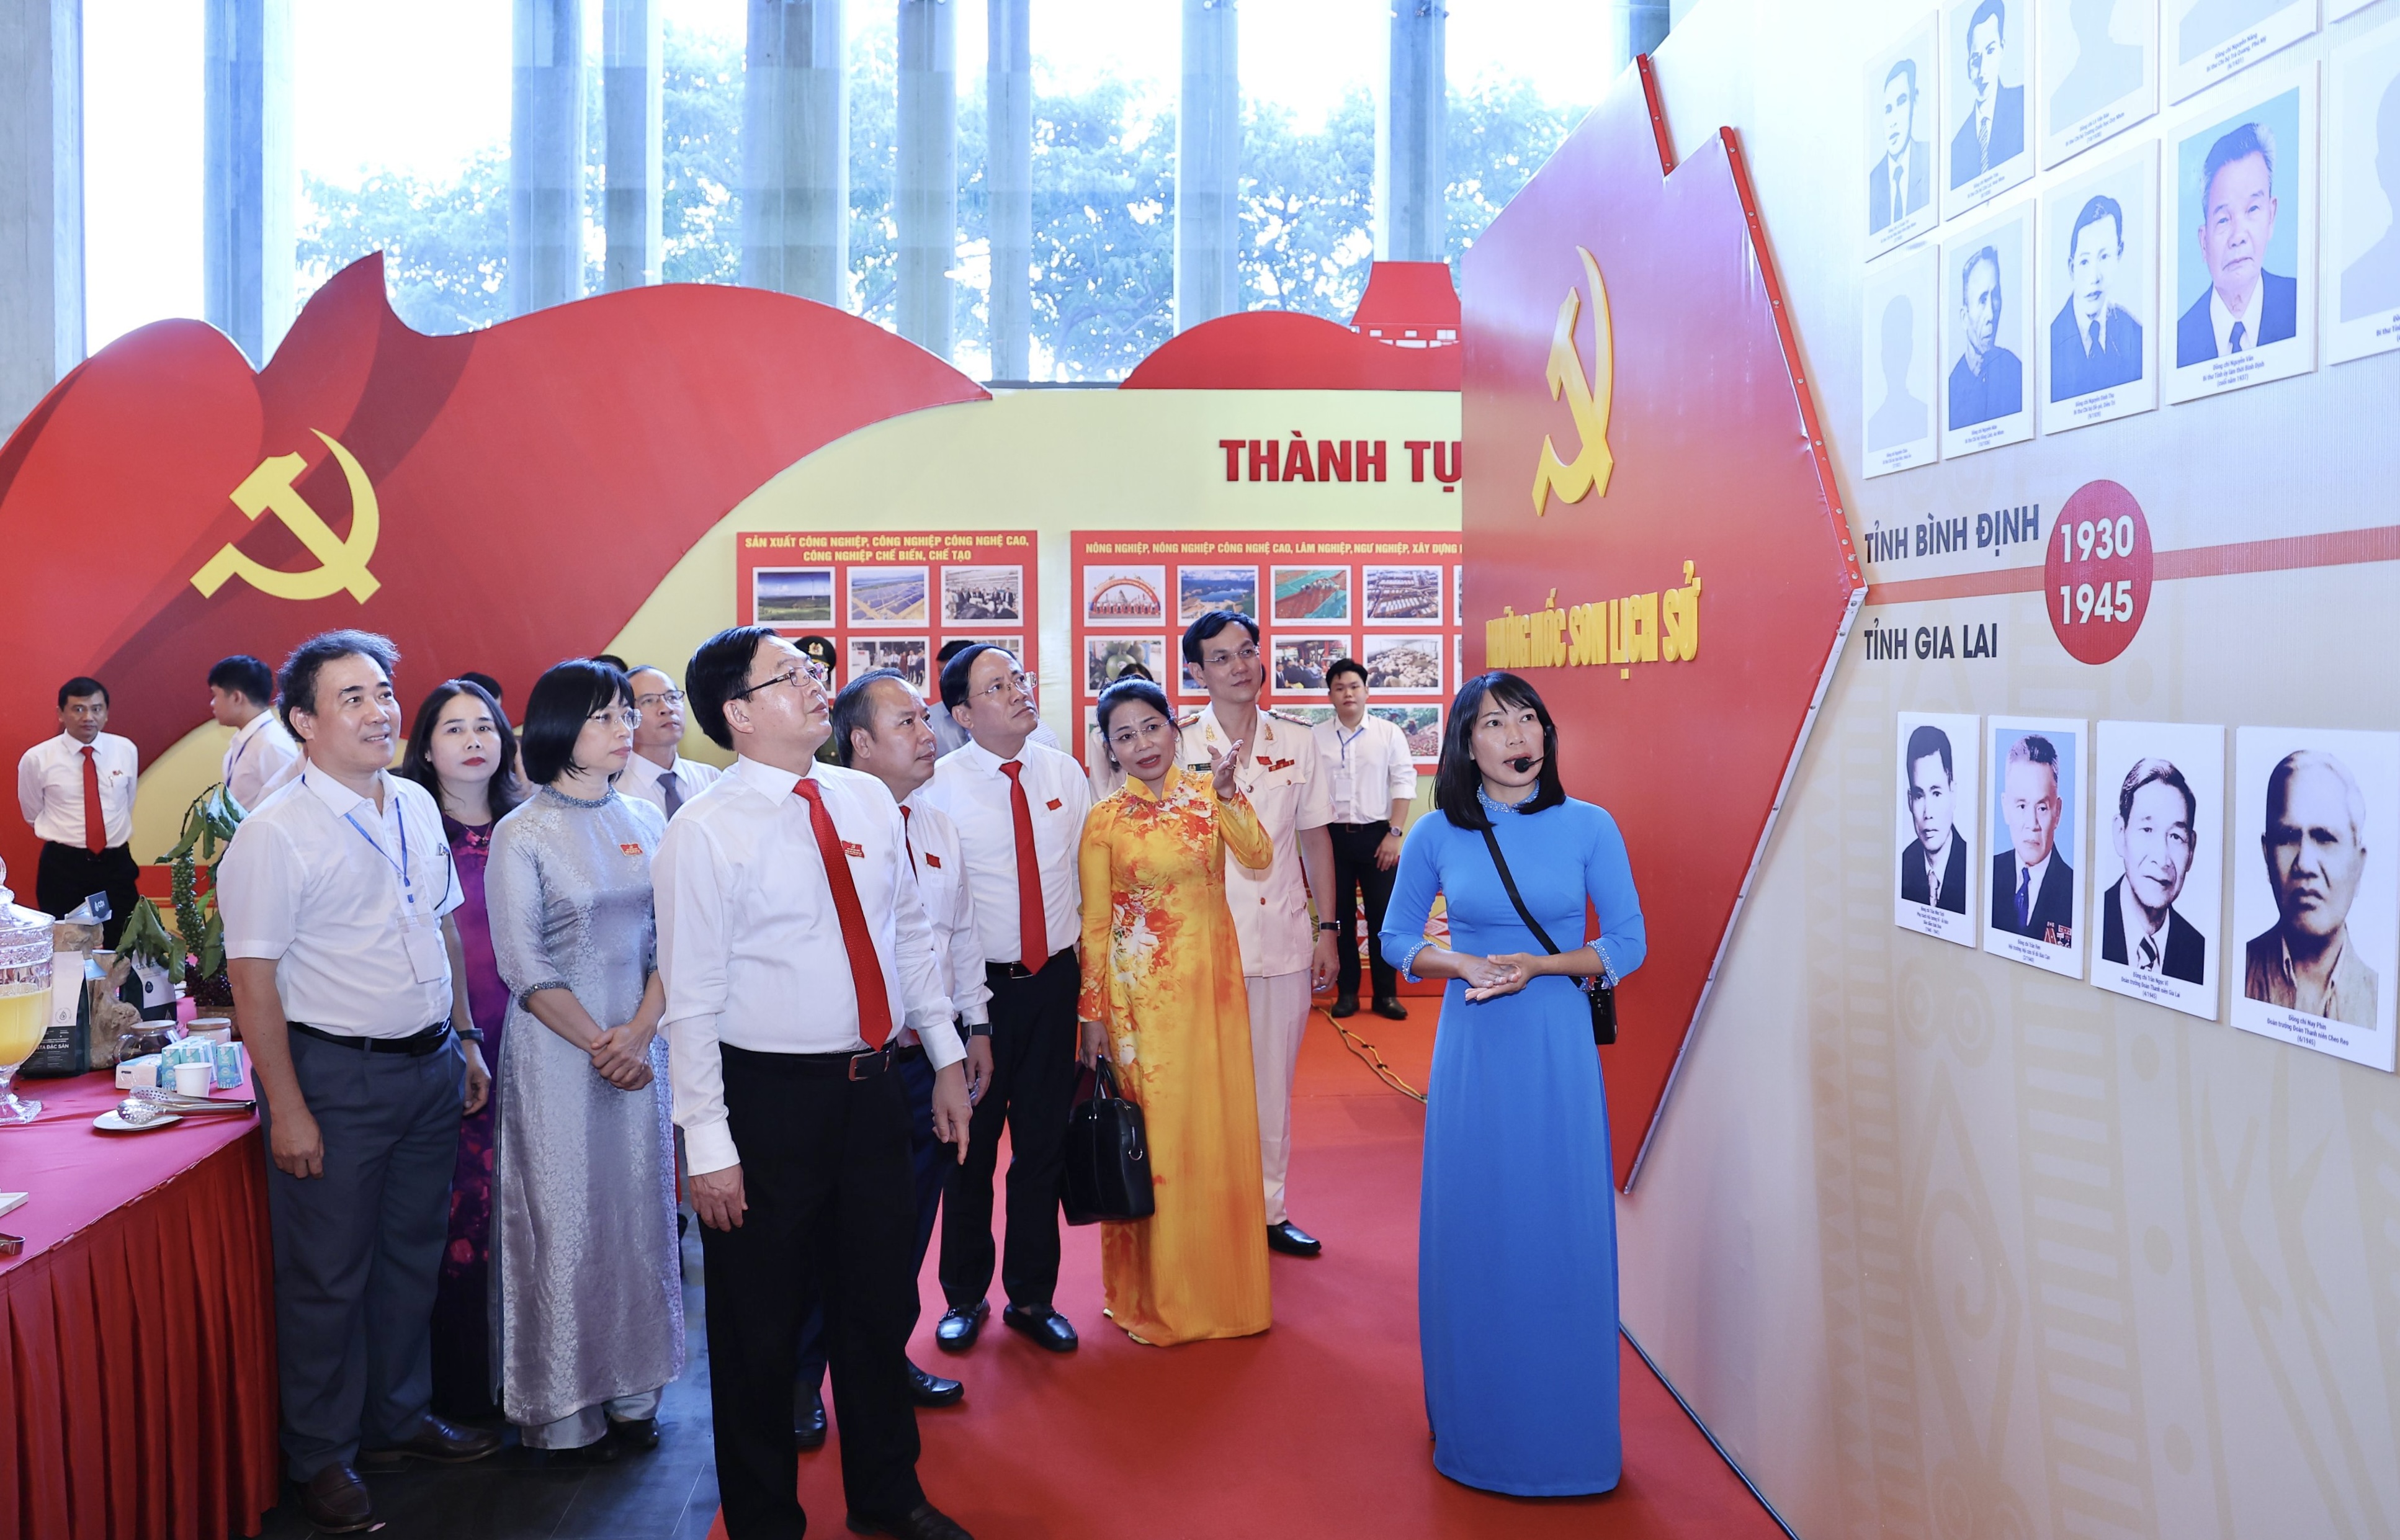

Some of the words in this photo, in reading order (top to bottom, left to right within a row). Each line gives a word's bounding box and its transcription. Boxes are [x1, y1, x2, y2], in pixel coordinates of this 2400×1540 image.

[1219, 430, 1386, 482] THÀNH
[745, 534, 768, 548] SẢN
[769, 534, 796, 548] XUẤT
[799, 535, 828, 547] CÔNG
[872, 535, 901, 547] CÔNG
[903, 534, 942, 548] NGHIỆP
[944, 535, 974, 547] CÔNG
[975, 534, 1003, 548] NGHỆ
[1006, 535, 1029, 547] CAO,
[1085, 541, 1112, 553] NÔNG
[1153, 541, 1179, 553] NÔNG
[1181, 541, 1215, 555] NGHIỆP
[1217, 541, 1243, 553] CÔNG
[1245, 541, 1271, 555] NGHỆ
[1272, 543, 1293, 554] CAO,
[1296, 541, 1315, 553] LÂM
[1353, 542, 1374, 553] NGƯ
[1412, 541, 1430, 553] XÂY
[1432, 542, 1457, 556] DỰNG
[1865, 520, 1907, 563] TỈNH
[1916, 513, 1967, 556] BÌNH
[1976, 504, 2039, 557] ĐỊNH
[2061, 515, 2134, 563] 1930
[803, 550, 833, 562] CÔNG
[835, 548, 874, 563] NGHIỆP
[875, 548, 896, 562] CHẾ
[928, 547, 949, 561] CHẾ
[951, 550, 972, 562] TẠO
[1530, 588, 1567, 668] MỐC
[1610, 591, 1658, 679] LỊCH
[1662, 560, 1701, 662] SỬ
[2060, 580, 2133, 625] 1945
[1864, 618, 1907, 660] TỈNH
[1915, 626, 1954, 660] GIA
[1963, 623, 1997, 658] LAI
[2267, 1018, 2277, 1026] Đoàn
[2293, 1024, 2303, 1033] Đoàn
[2304, 1027, 2317, 1037] Thanh
[2318, 1032, 2327, 1040] niên
[2328, 1034, 2339, 1043] Cheo
[2340, 1037, 2349, 1045] Reo
[2288, 1014, 2299, 1024] Đồng
